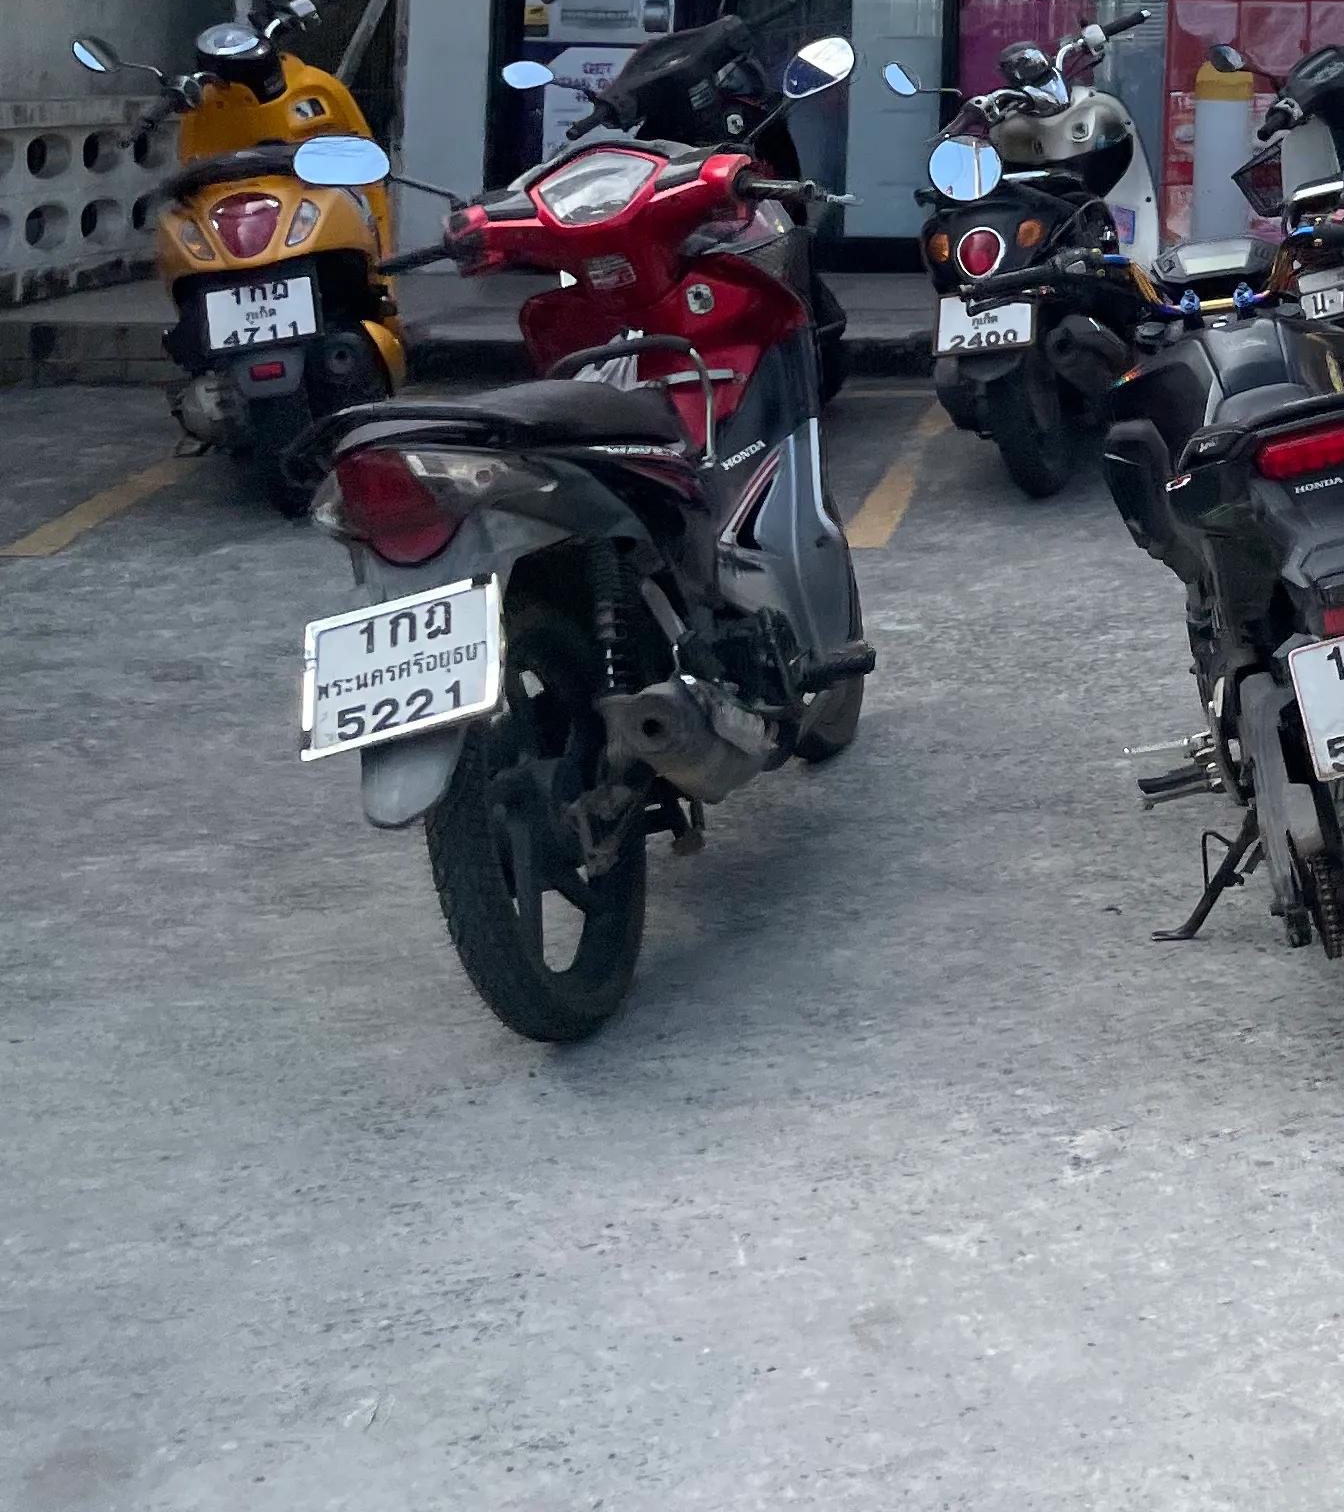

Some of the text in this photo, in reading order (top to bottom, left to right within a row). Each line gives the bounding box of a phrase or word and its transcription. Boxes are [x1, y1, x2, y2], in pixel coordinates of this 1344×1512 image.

[223, 320, 299, 346] 4711
[721, 439, 767, 471] HONDA
[1294, 477, 1344, 494] HONDA
[317, 640, 487, 701] พระนครศรีอยุธยา
[337, 680, 463, 742] 5221
